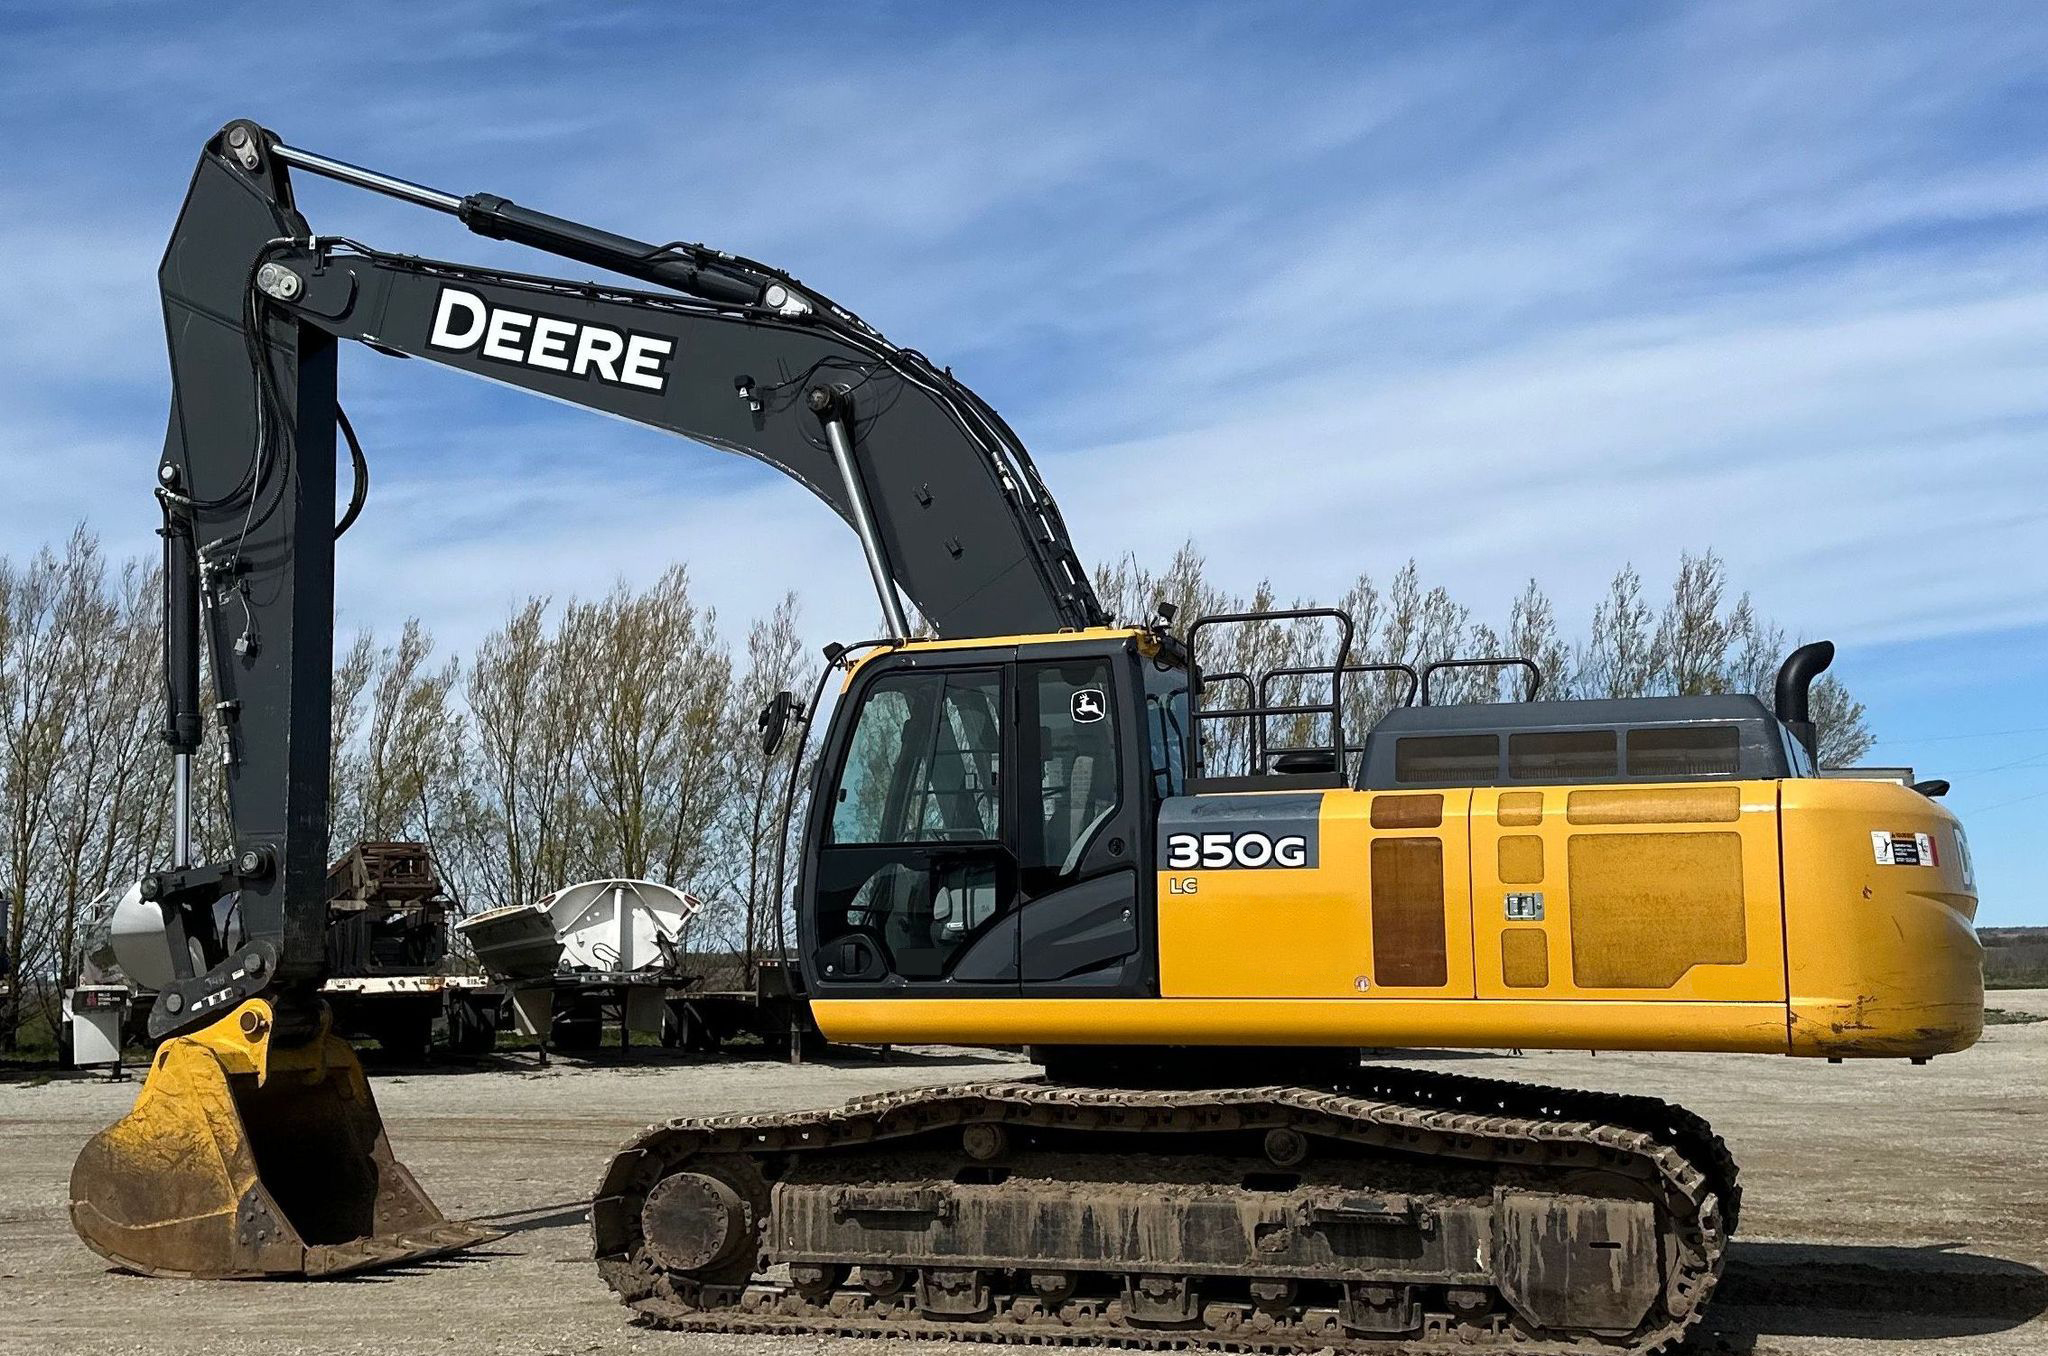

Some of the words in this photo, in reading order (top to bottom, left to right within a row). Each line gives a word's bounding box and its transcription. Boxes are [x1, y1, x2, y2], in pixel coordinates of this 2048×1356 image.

[430, 287, 672, 390] DEERE
[1169, 832, 1305, 868] 350G
[1170, 878, 1197, 894] LC
